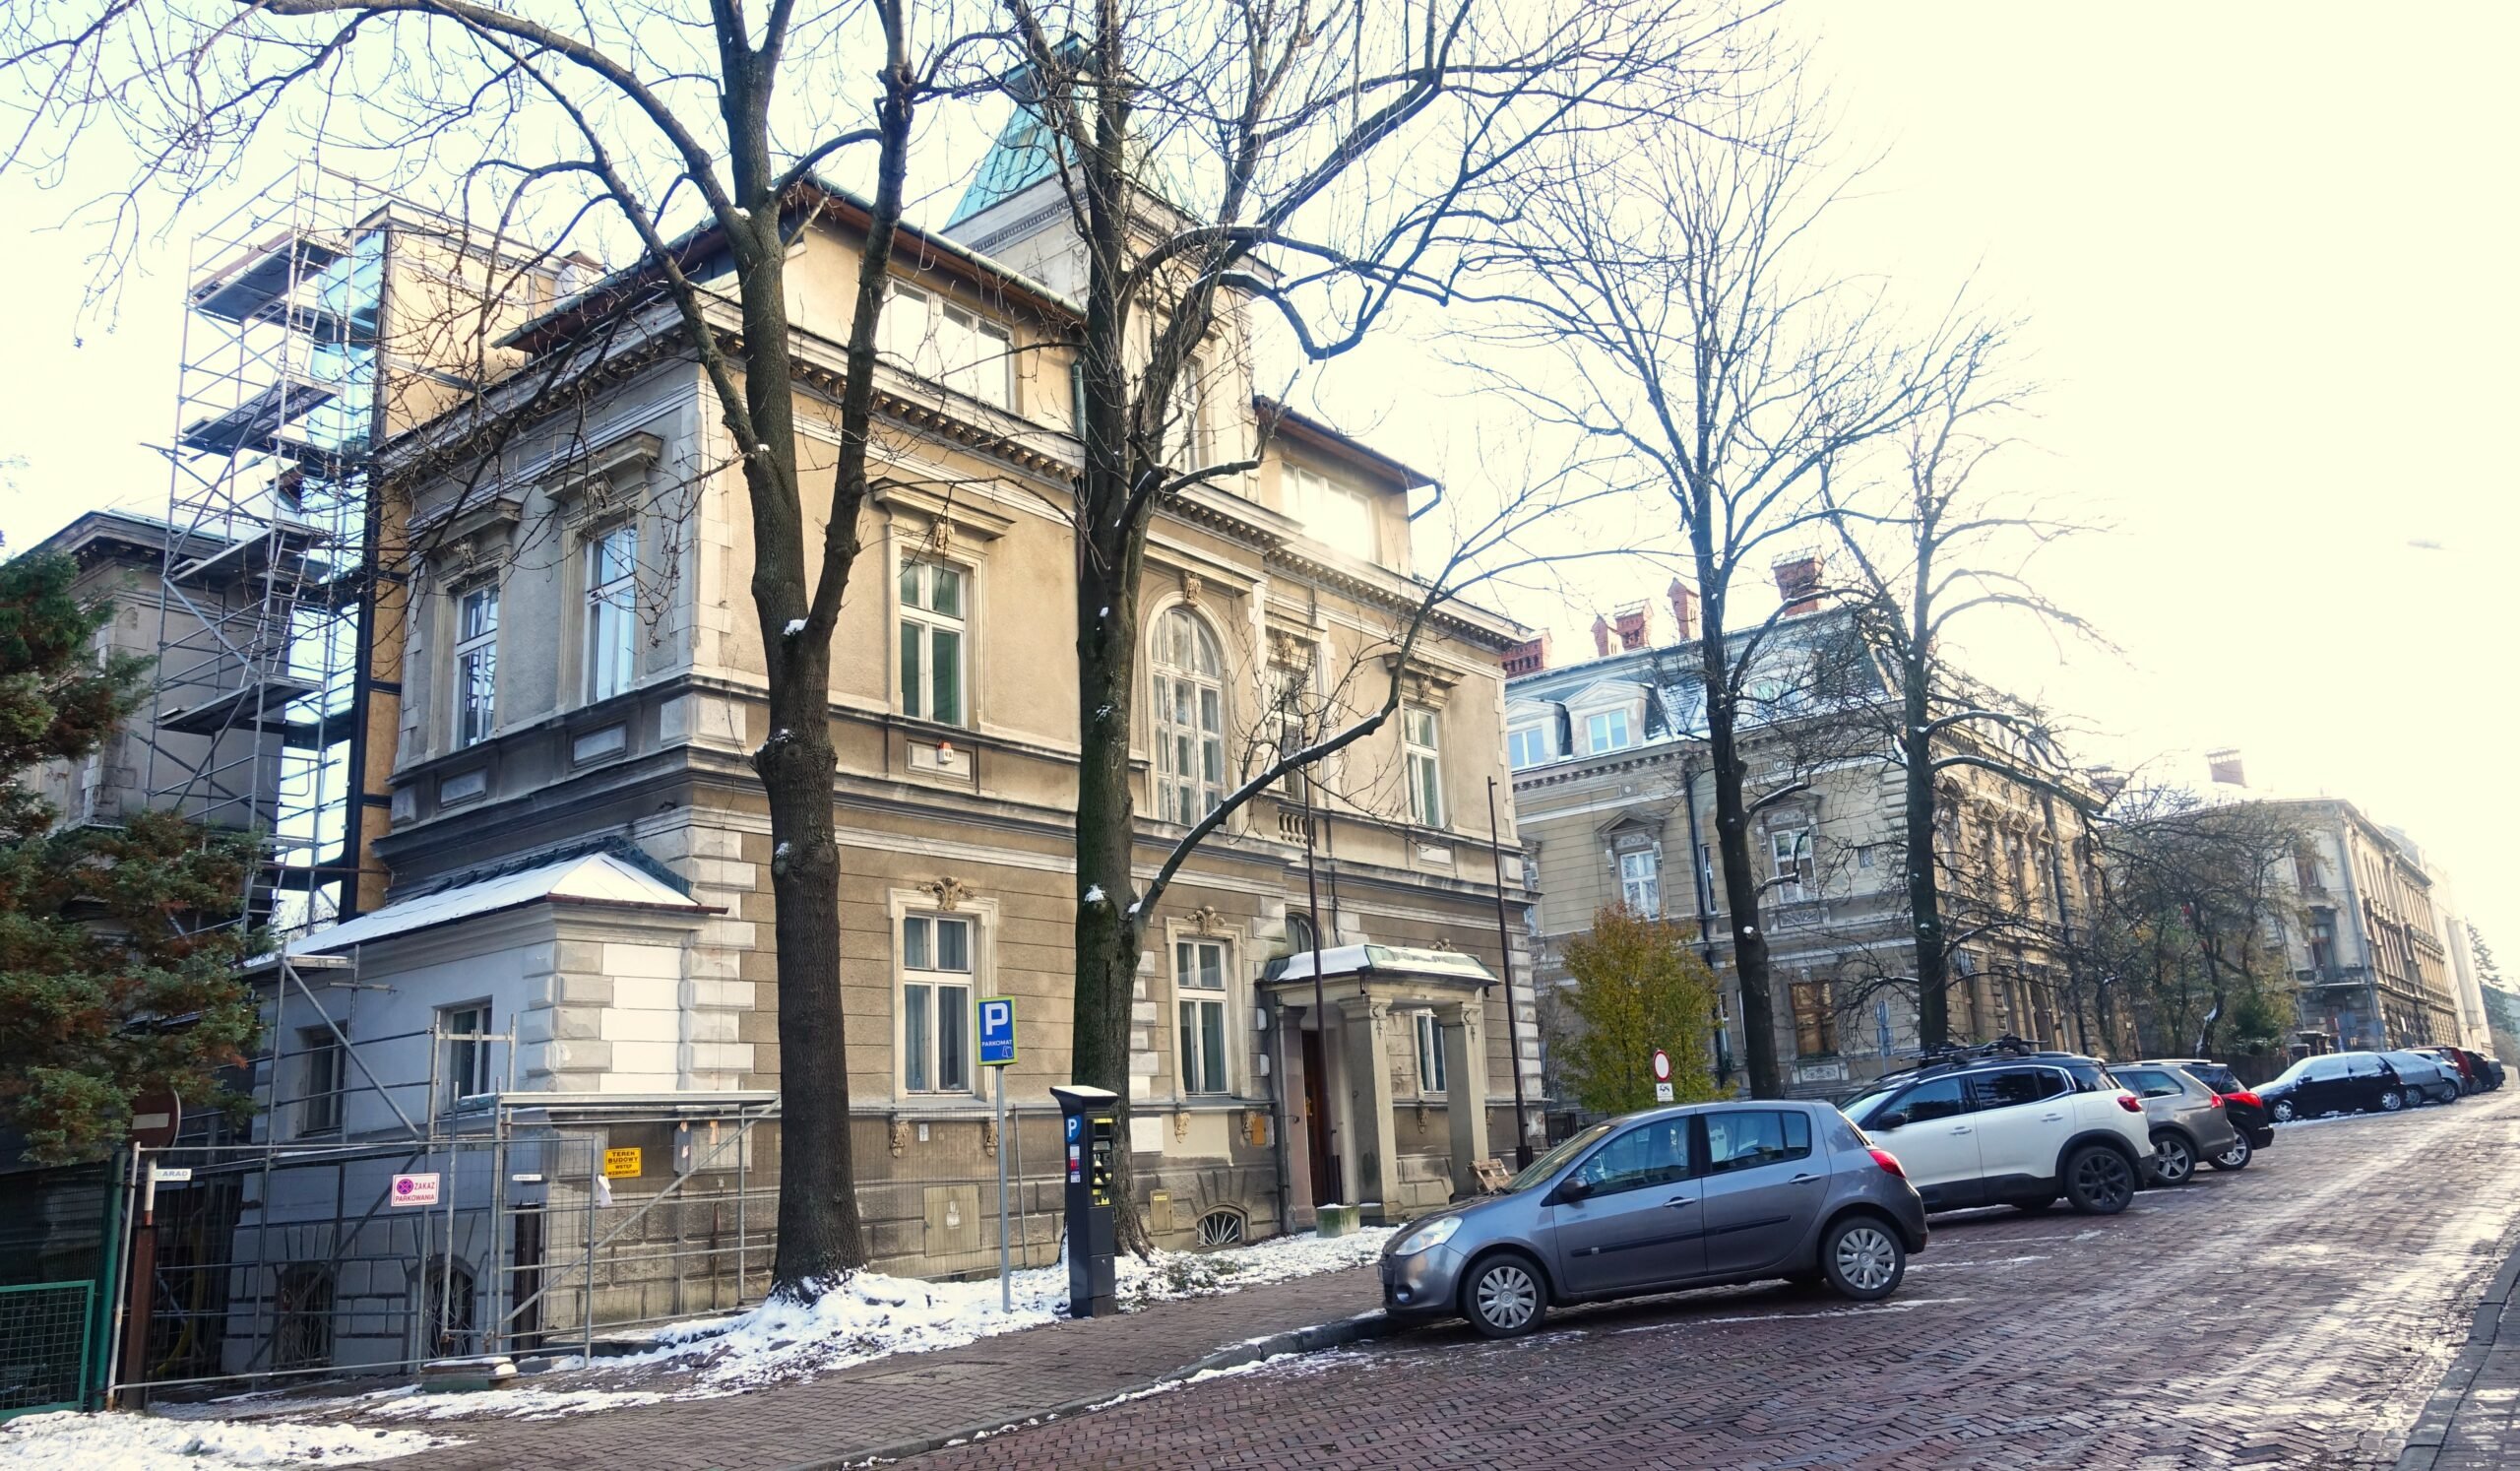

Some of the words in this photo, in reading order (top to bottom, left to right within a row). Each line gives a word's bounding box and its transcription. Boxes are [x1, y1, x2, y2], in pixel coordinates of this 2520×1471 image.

[984, 1002, 1008, 1035] P
[1068, 1119, 1077, 1137] P
[413, 1182, 435, 1190] ZAKAZ
